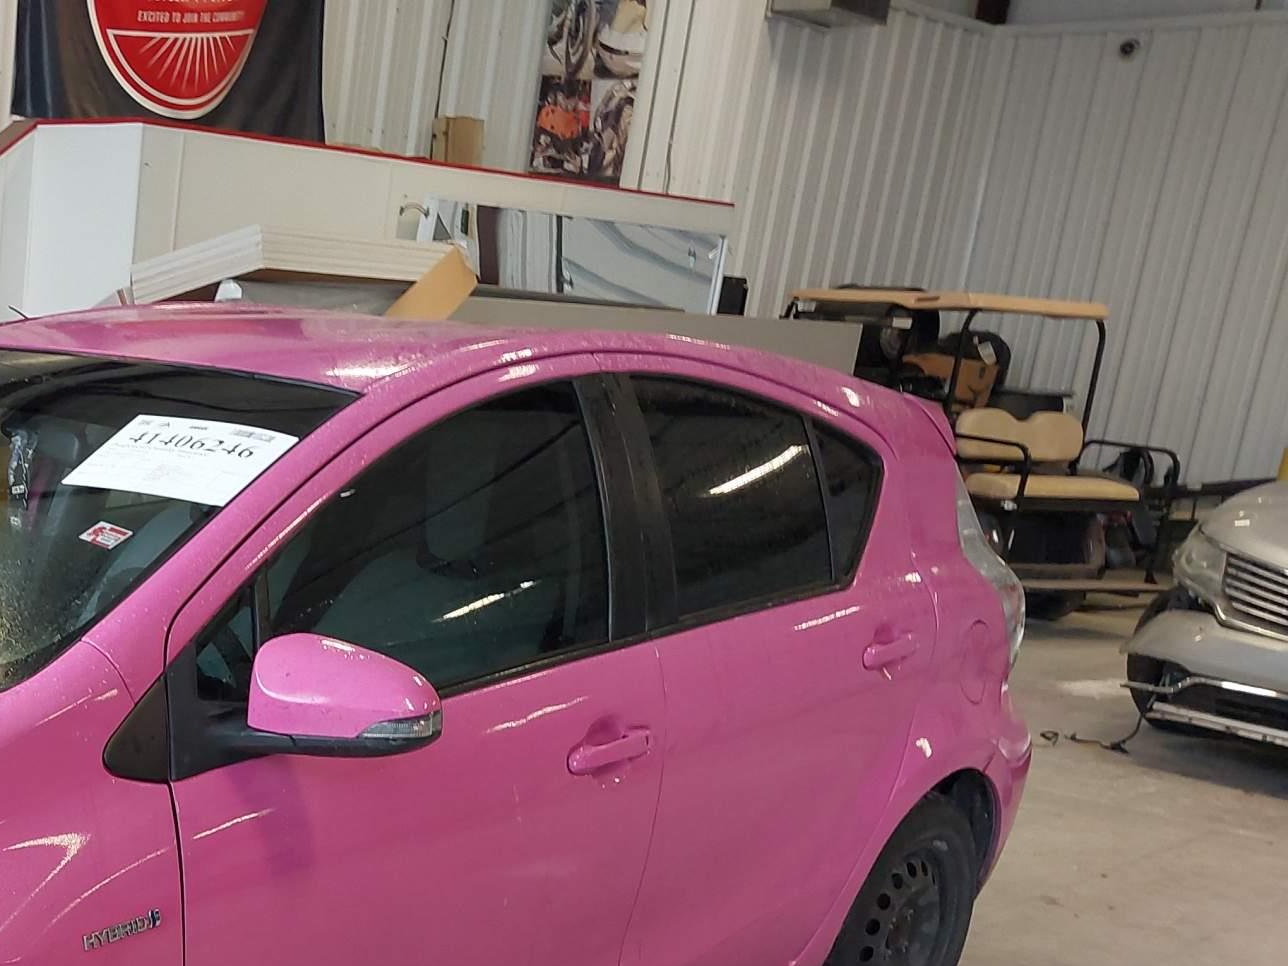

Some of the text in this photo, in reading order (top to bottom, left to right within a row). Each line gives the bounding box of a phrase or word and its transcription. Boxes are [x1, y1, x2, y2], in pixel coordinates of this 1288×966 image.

[137, 10, 170, 23] EXCITED
[172, 11, 182, 23] TO
[129, 431, 257, 459] 41406246
[82, 916, 148, 951] HYBRID
